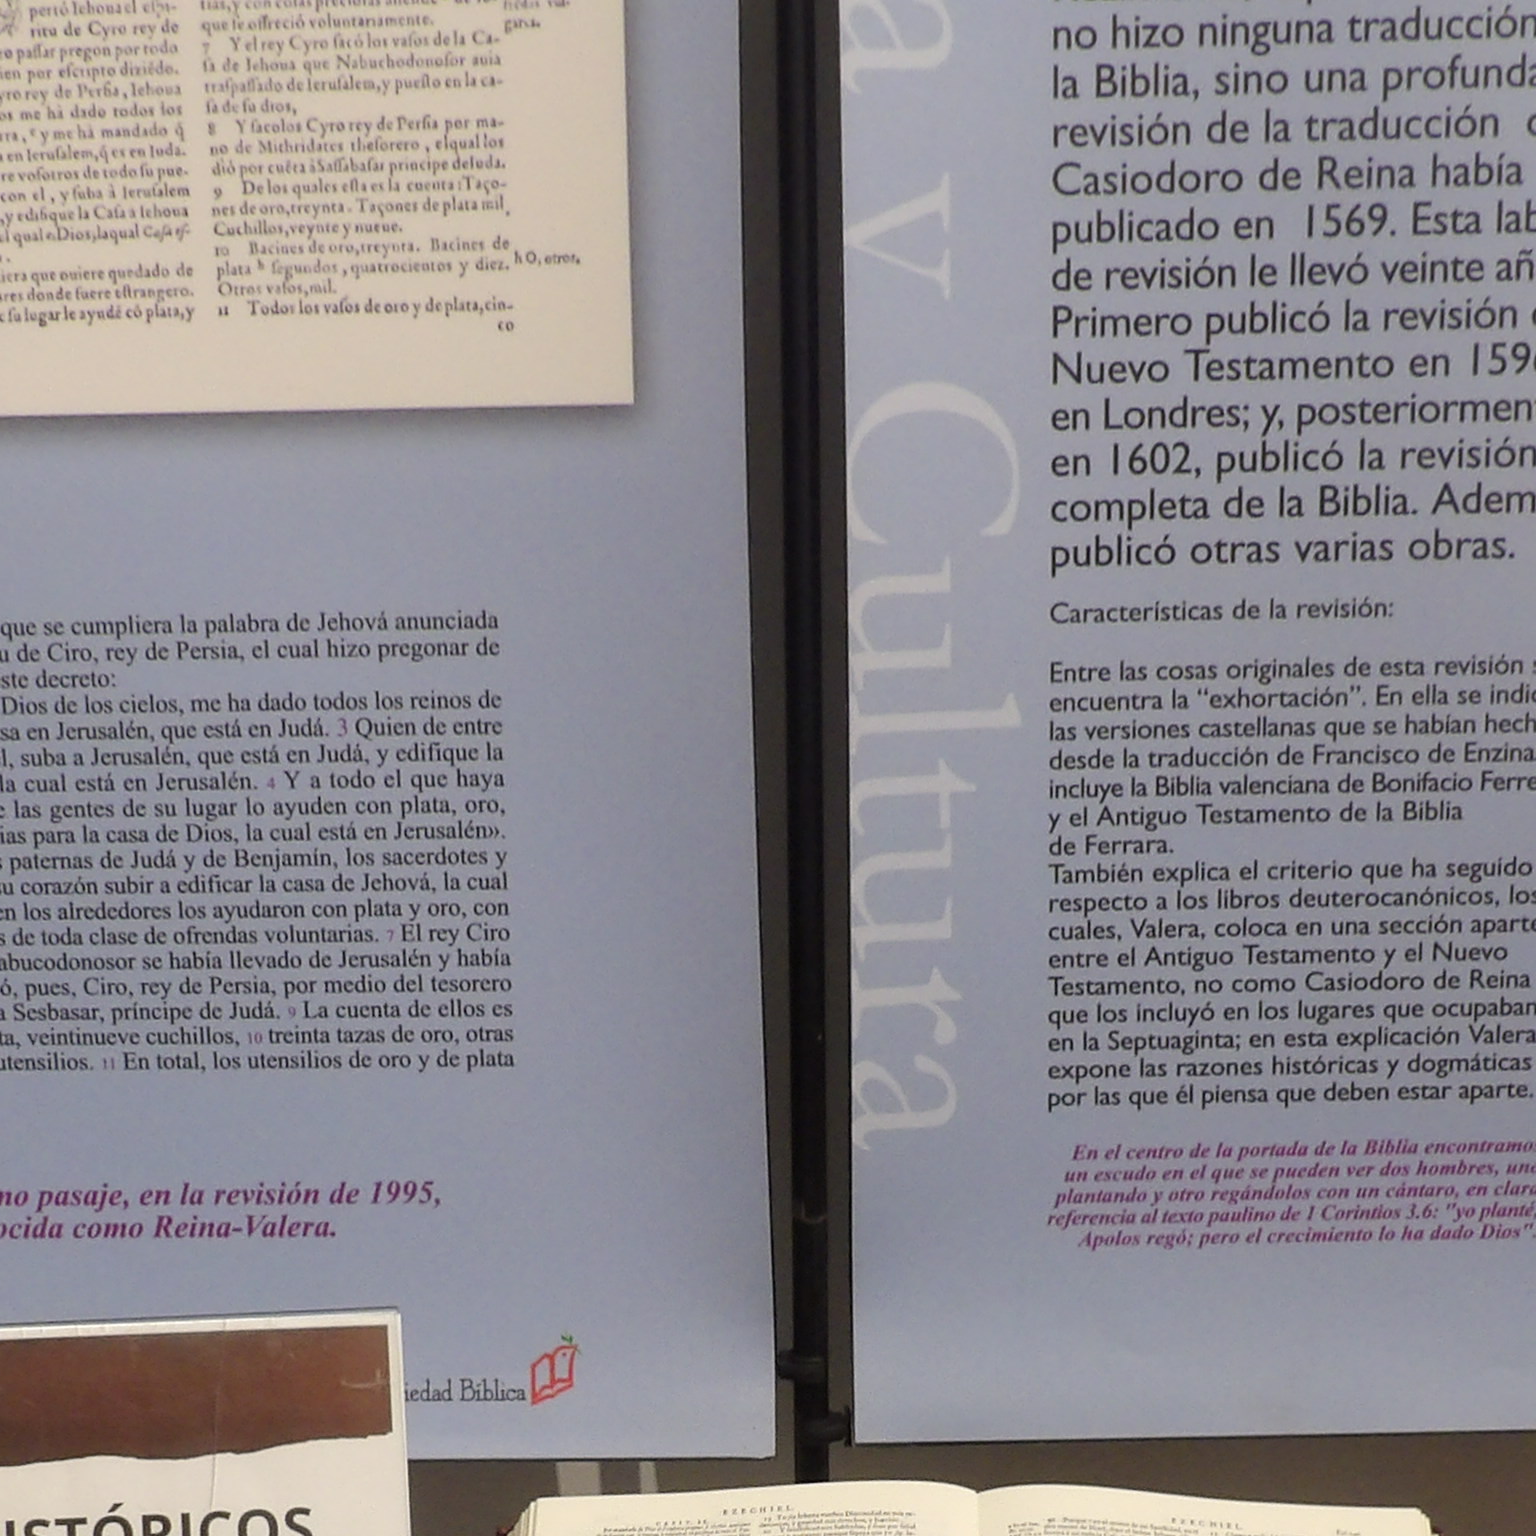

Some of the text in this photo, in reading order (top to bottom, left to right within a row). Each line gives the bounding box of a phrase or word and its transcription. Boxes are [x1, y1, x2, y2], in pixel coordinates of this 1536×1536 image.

[1052, 24, 1098, 51] no
[1111, 12, 1185, 50] hizo
[1198, 12, 1336, 57] ninguna
[1051, 205, 1221, 256] publicado
[1233, 215, 1275, 241] en
[1306, 201, 1397, 239] 1569.
[1411, 200, 1483, 237] Esta
[1051, 350, 1171, 386] Nuevo
[1183, 347, 1395, 383] Testamento
[1408, 353, 1451, 379] en
[1050, 407, 1091, 432] en
[1103, 394, 1250, 433] Londres;
[1260, 403, 1285, 438] y,
[1050, 527, 1515, 579] publicó otras varias obras.
[1049, 595, 1394, 625] Características de la revisión:
[847, 380, 1022, 1153] Cultura
[1048, 833, 1175, 857] de Ferrara.
[34, 1182, 130, 1214] pasaje,
[139, 1188, 172, 1207] en
[179, 1181, 205, 1207] la
[213, 1180, 320, 1207] revisión
[328, 1180, 361, 1206] de
[370, 1179, 441, 1209] 1995,
[72, 1221, 144, 1240] como
[152, 1213, 337, 1239] Reina-Valera.
[404, 1377, 527, 1404] iedad Bíblica
